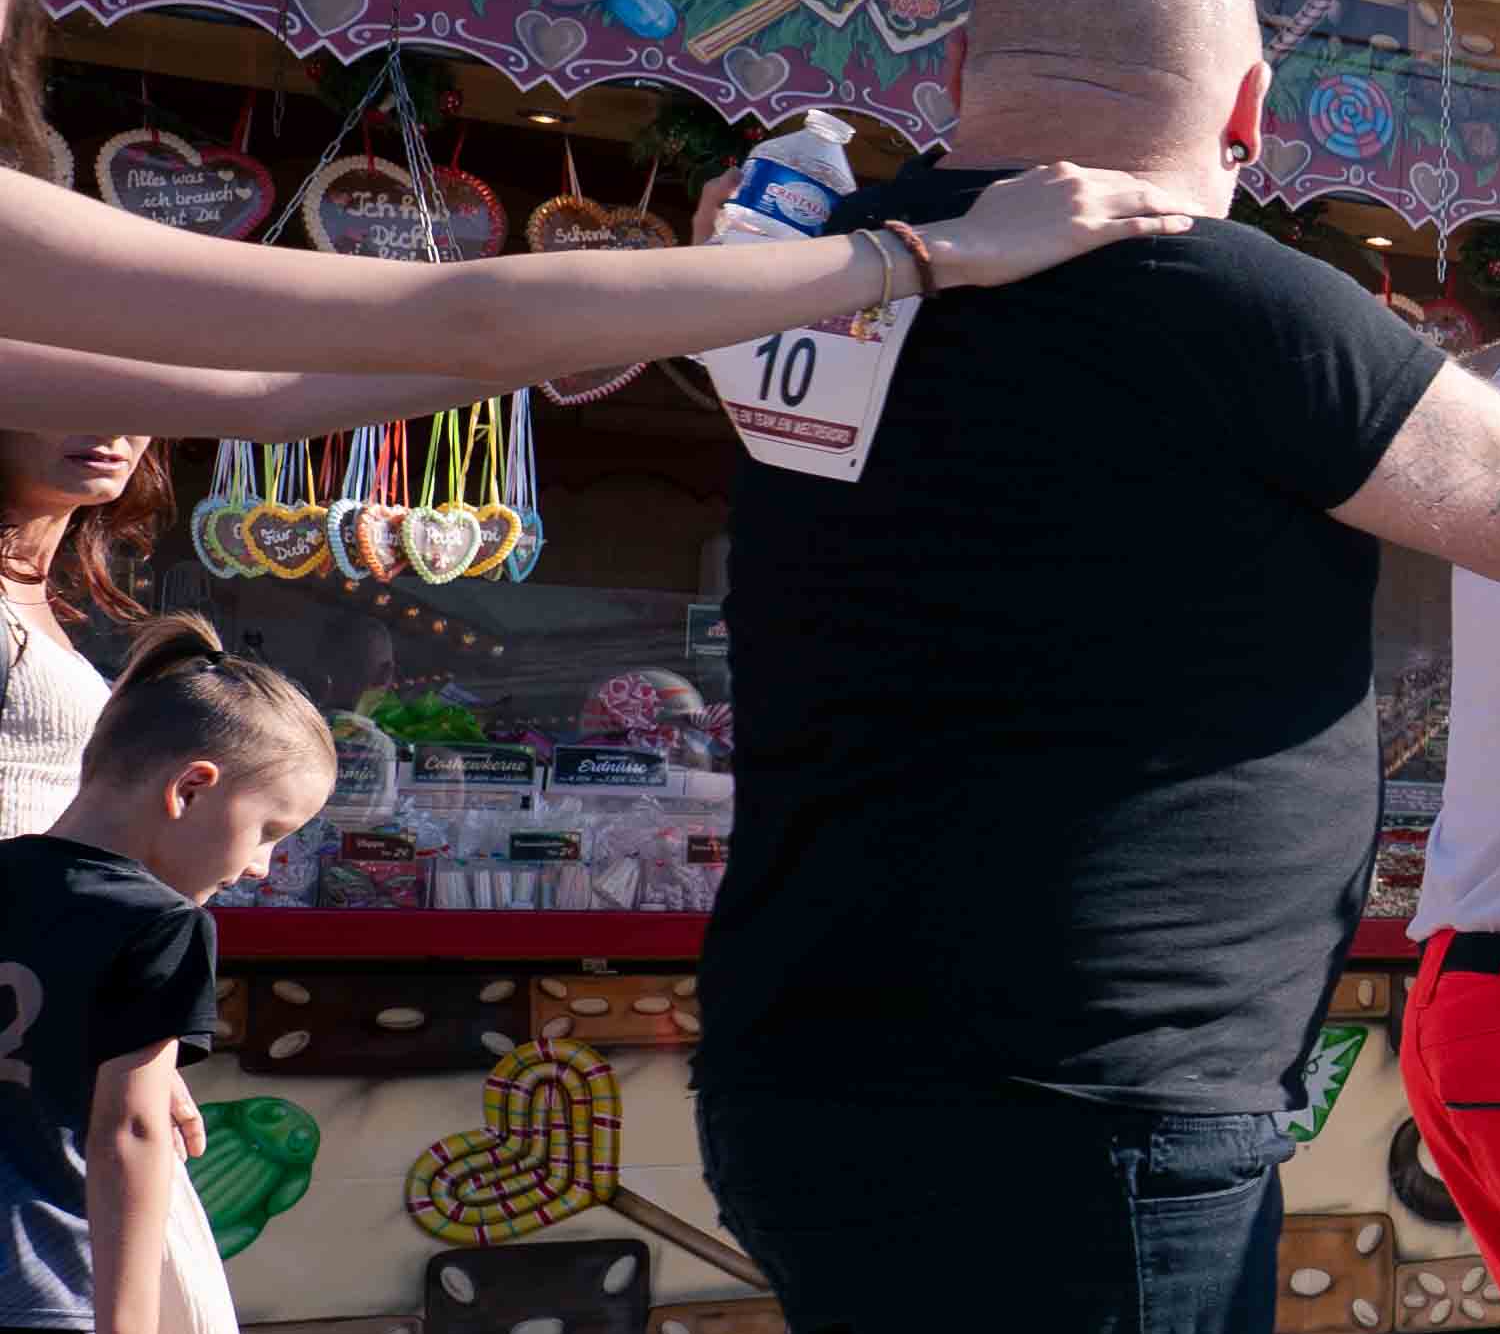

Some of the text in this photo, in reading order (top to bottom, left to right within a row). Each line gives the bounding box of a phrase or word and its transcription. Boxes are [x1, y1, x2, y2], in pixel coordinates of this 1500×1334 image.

[171, 171, 206, 186] was
[195, 207, 221, 224] Du
[755, 331, 817, 408] 10
[424, 755, 527, 773] Cashewkerne
